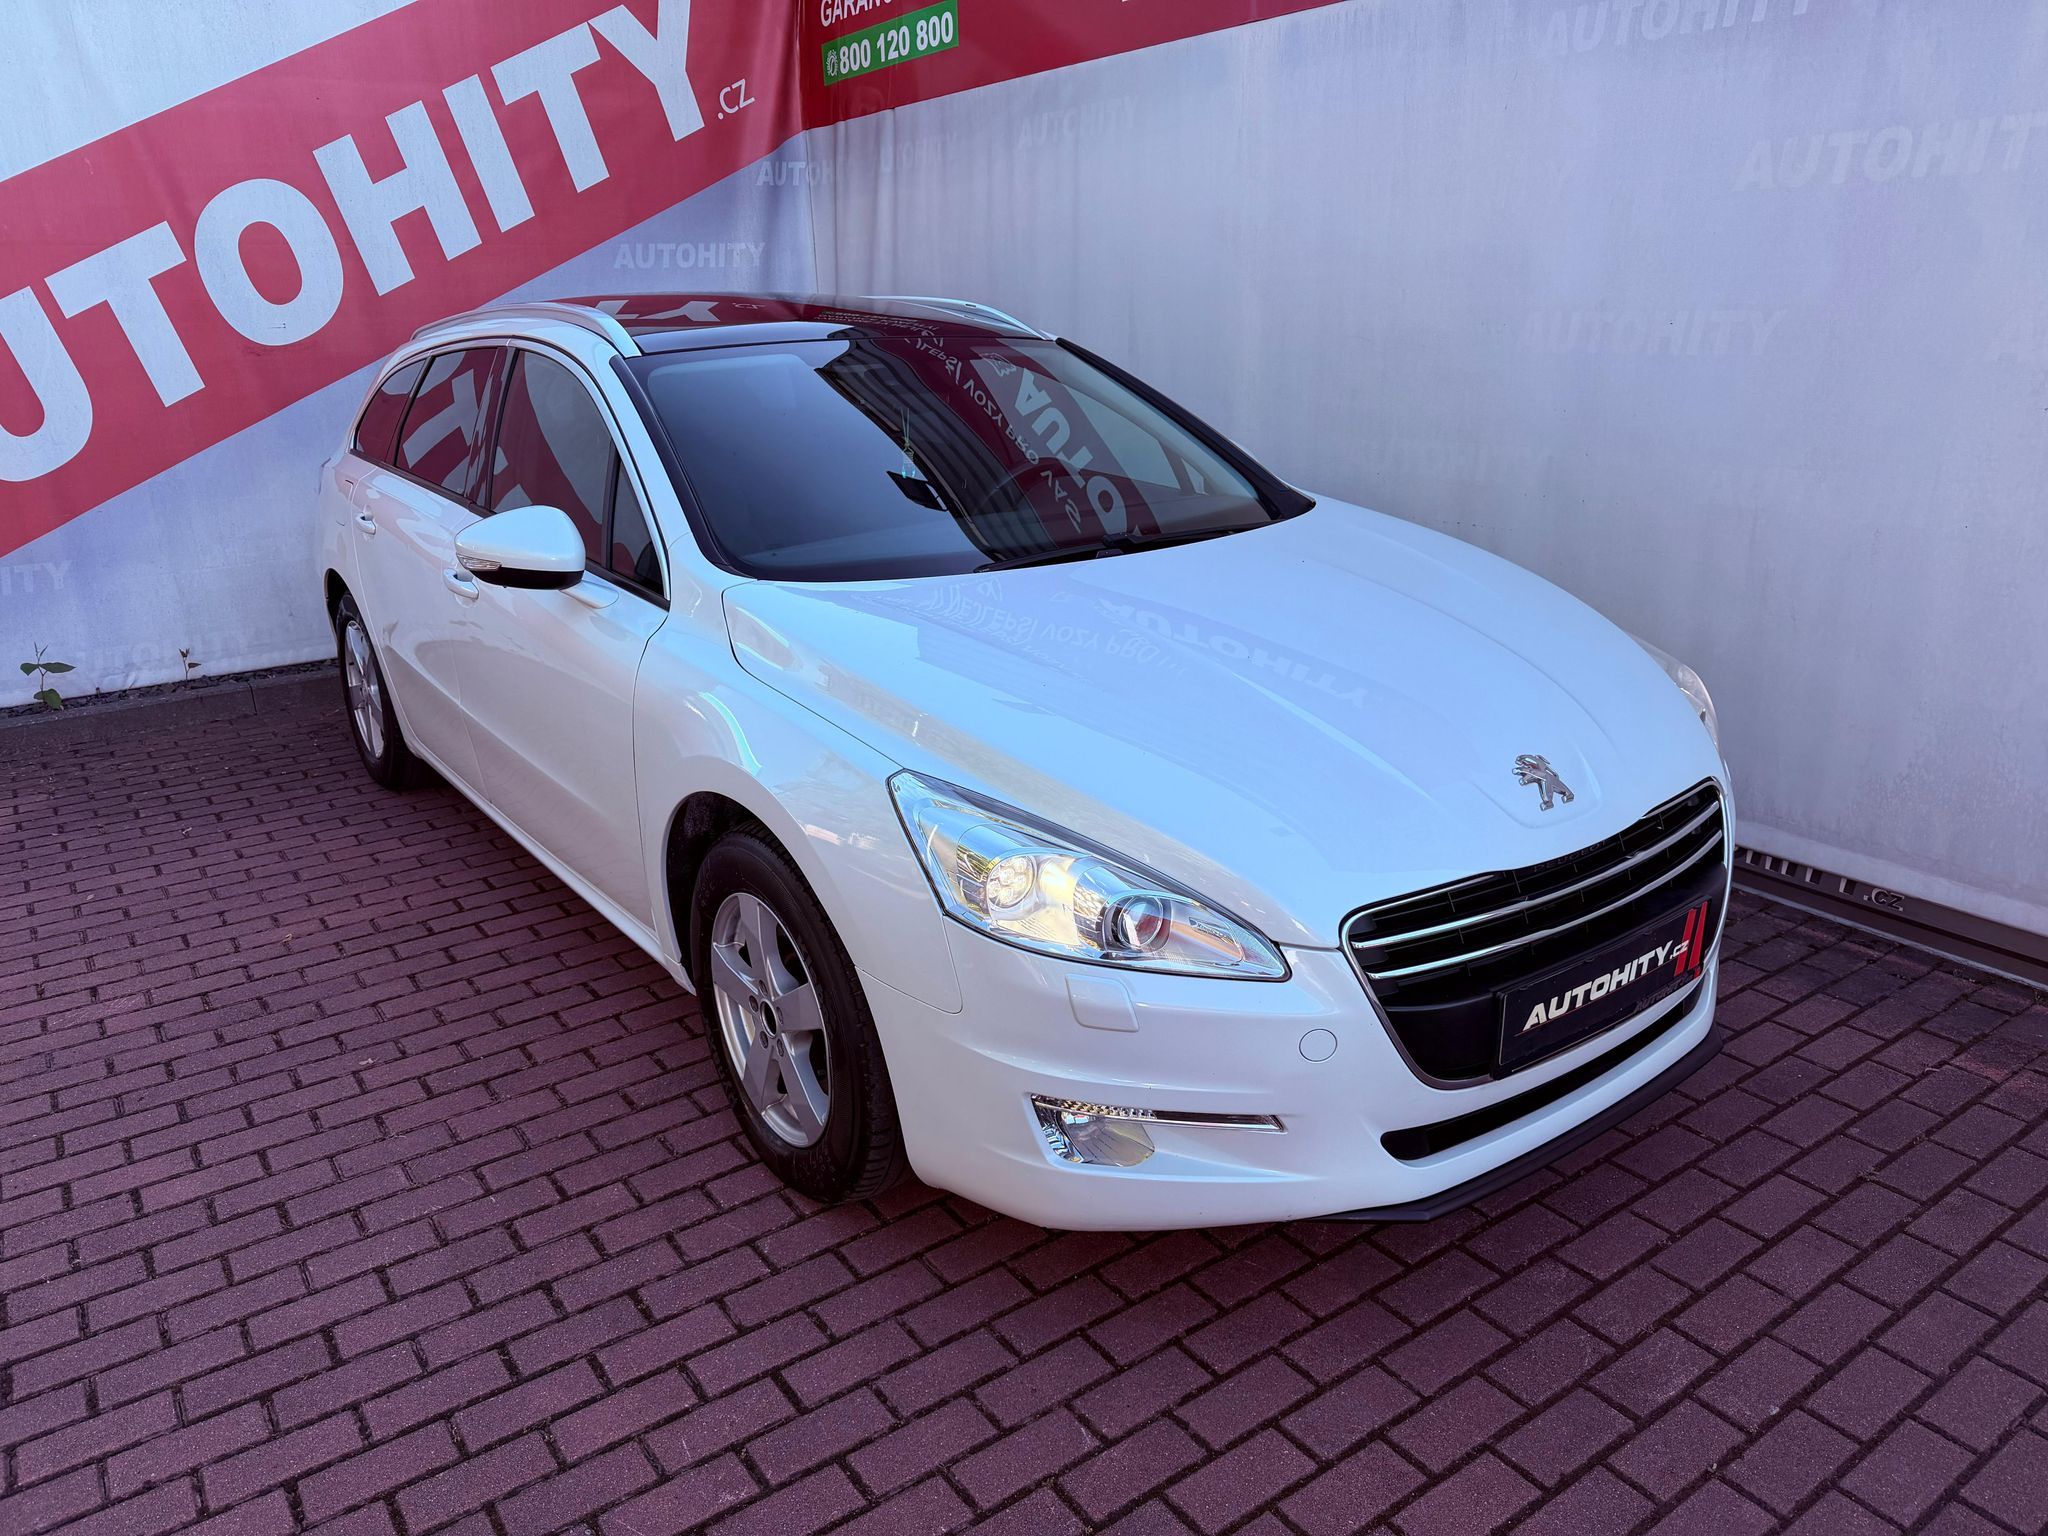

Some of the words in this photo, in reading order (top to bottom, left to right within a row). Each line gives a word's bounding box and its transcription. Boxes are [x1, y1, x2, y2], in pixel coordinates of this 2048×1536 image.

[821, 0, 893, 27] GAR
[840, 38, 871, 74] 800
[877, 25, 910, 62] 120
[916, 11, 954, 51] 800
[614, 242, 766, 270] AUTOHITY
